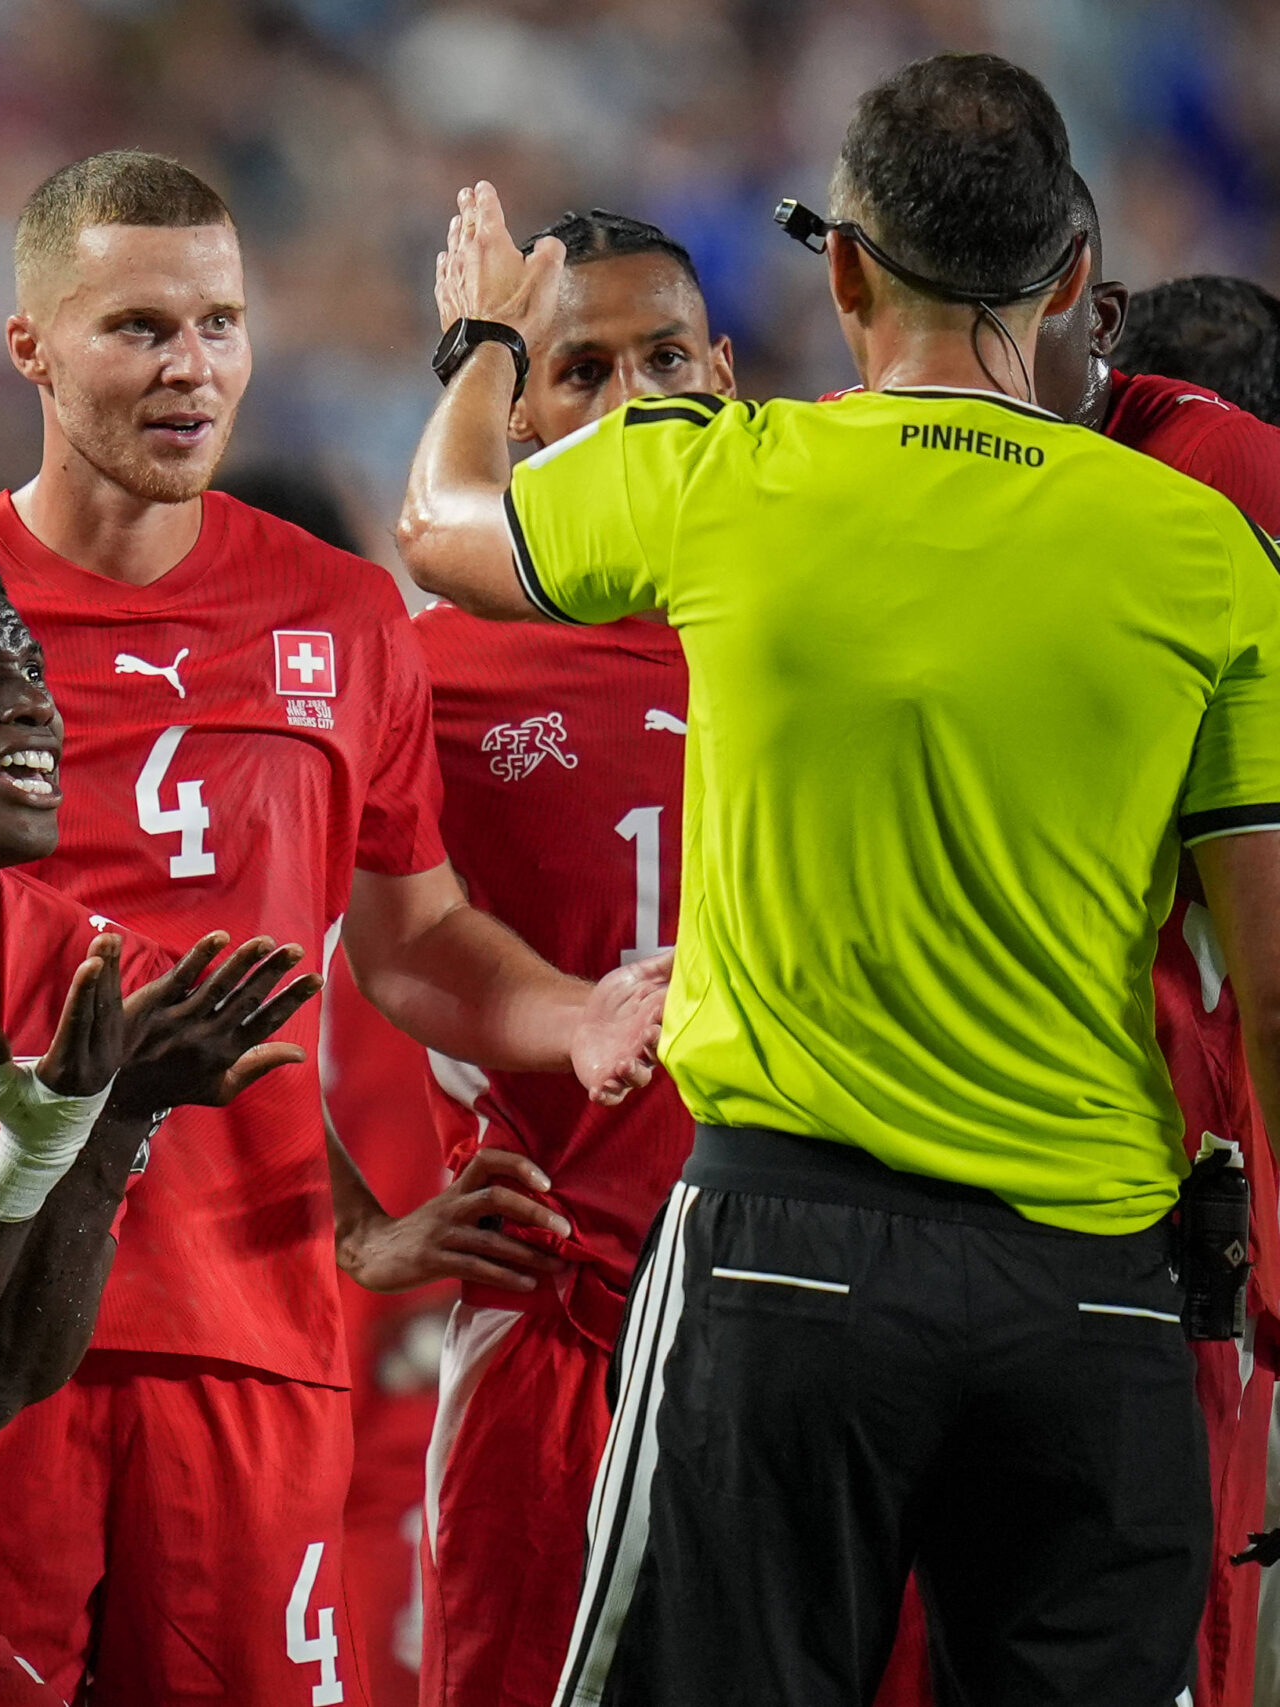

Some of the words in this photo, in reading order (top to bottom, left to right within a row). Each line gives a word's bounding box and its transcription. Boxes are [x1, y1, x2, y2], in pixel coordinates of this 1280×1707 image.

[900, 424, 1045, 468] PINHEIRO
[287, 717, 317, 728] KANSAS
[317, 718, 335, 730] CITY
[135, 725, 216, 878] 4
[286, 1542, 344, 1707] 4
